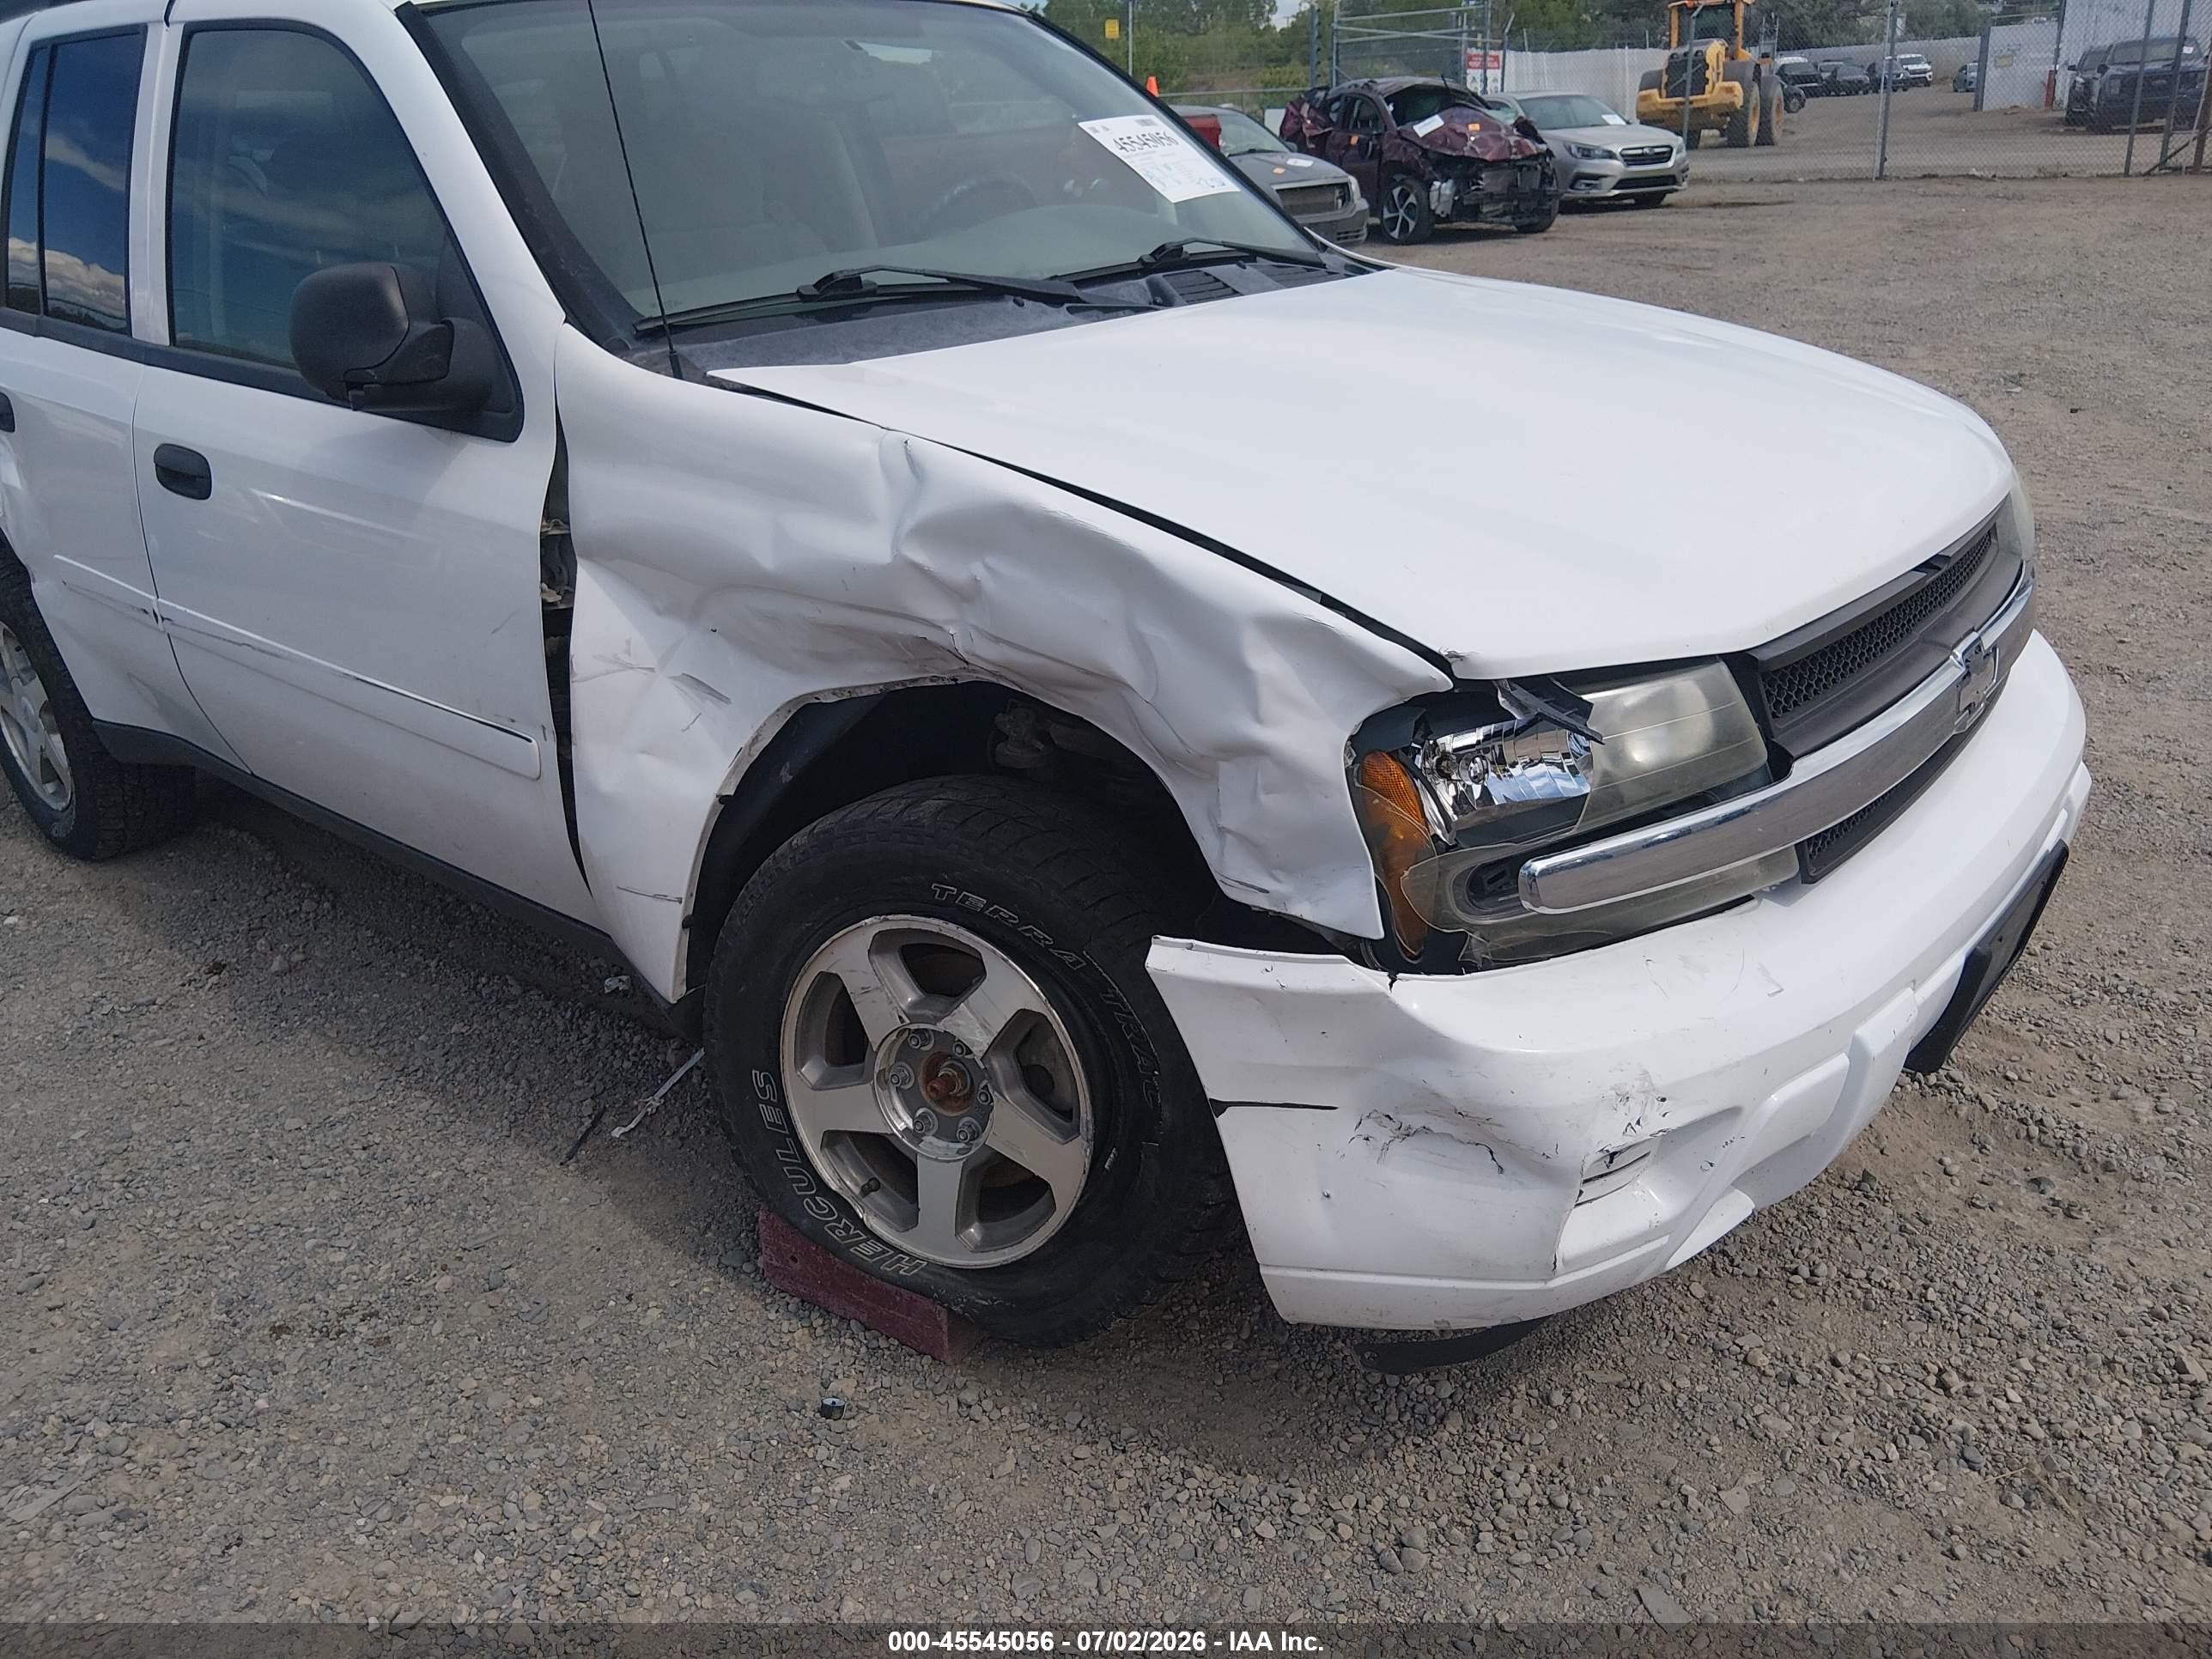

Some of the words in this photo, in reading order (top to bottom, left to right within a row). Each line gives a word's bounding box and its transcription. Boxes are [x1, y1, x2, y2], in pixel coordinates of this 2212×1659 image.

[1113, 131, 1181, 153] 45545056
[931, 883, 1088, 971] TERRA
[751, 1070, 928, 1277] HERCULES
